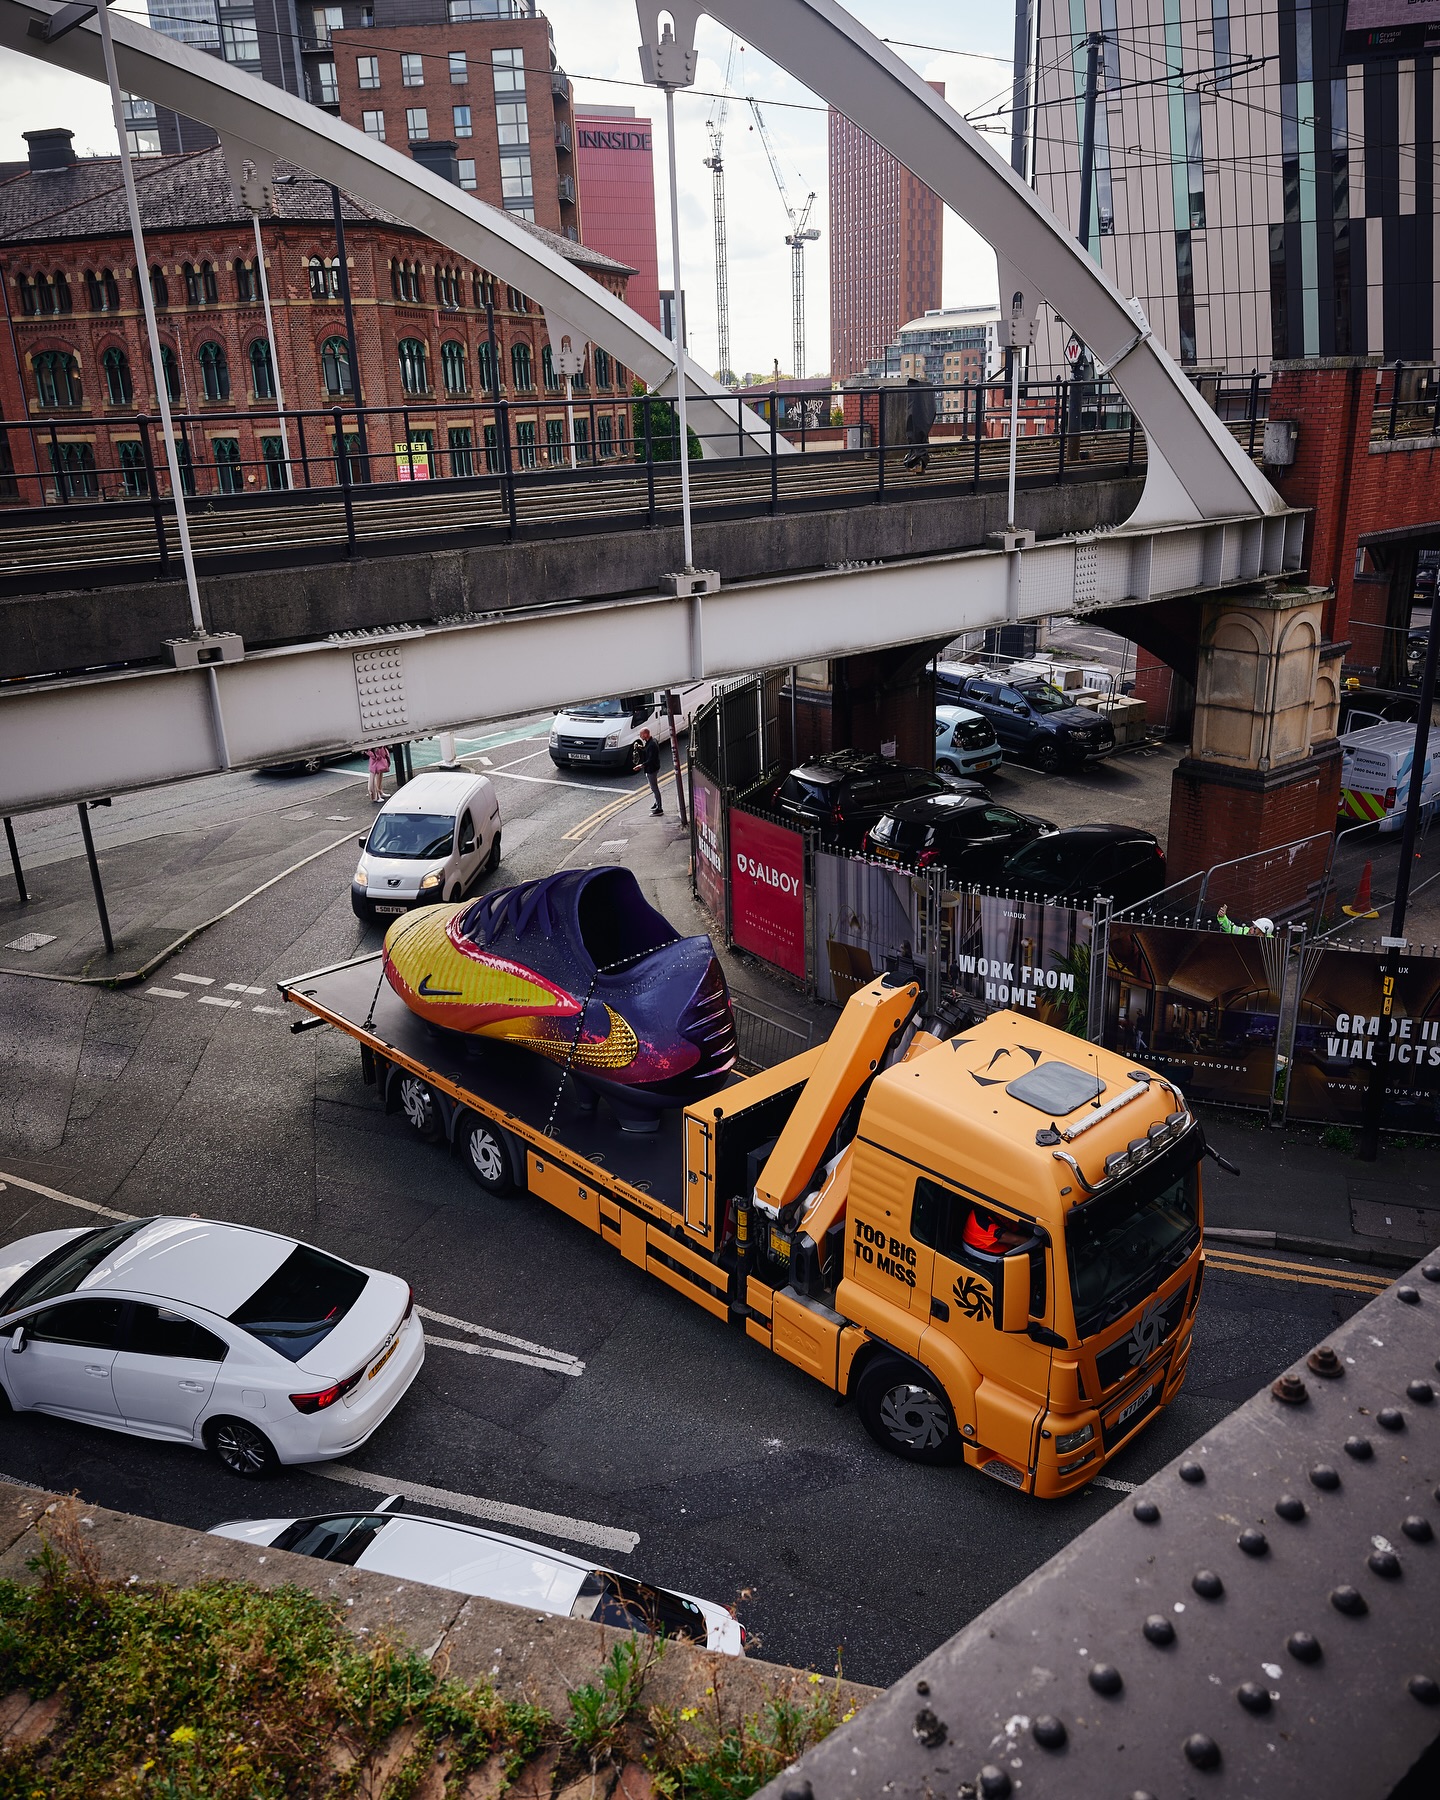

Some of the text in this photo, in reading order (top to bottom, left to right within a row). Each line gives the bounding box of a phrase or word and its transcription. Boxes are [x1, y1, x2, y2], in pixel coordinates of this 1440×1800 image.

[578, 130, 652, 151] INNSIDE
[1068, 345, 1079, 359] W
[1356, 757, 1386, 767] BROWNFIELD
[1350, 783, 1385, 792] PEUGEOT
[748, 858, 799, 896] SALBOY
[745, 909, 758, 919] CALL
[1003, 911, 1027, 920] VIADUX
[829, 969, 866, 985] RESIDENTS
[959, 954, 1075, 993] WORK FROM
[1380, 965, 1409, 974] VIUX
[985, 982, 1037, 1009] HOME
[1126, 1052, 1248, 1072] BRICKWORK CANOPIES
[1327, 1082, 1430, 1098] WWW.VDUX.UK
[501, 1119, 523, 1134] PHANTOM
[526, 1133, 536, 1141] LOW
[571, 1160, 594, 1176] HAALAND
[613, 1185, 638, 1202] PHANTOM
[642, 1202, 654, 1211] LOW
[854, 1217, 917, 1268] TOO BIG
[853, 1238, 917, 1288] TO MISS
